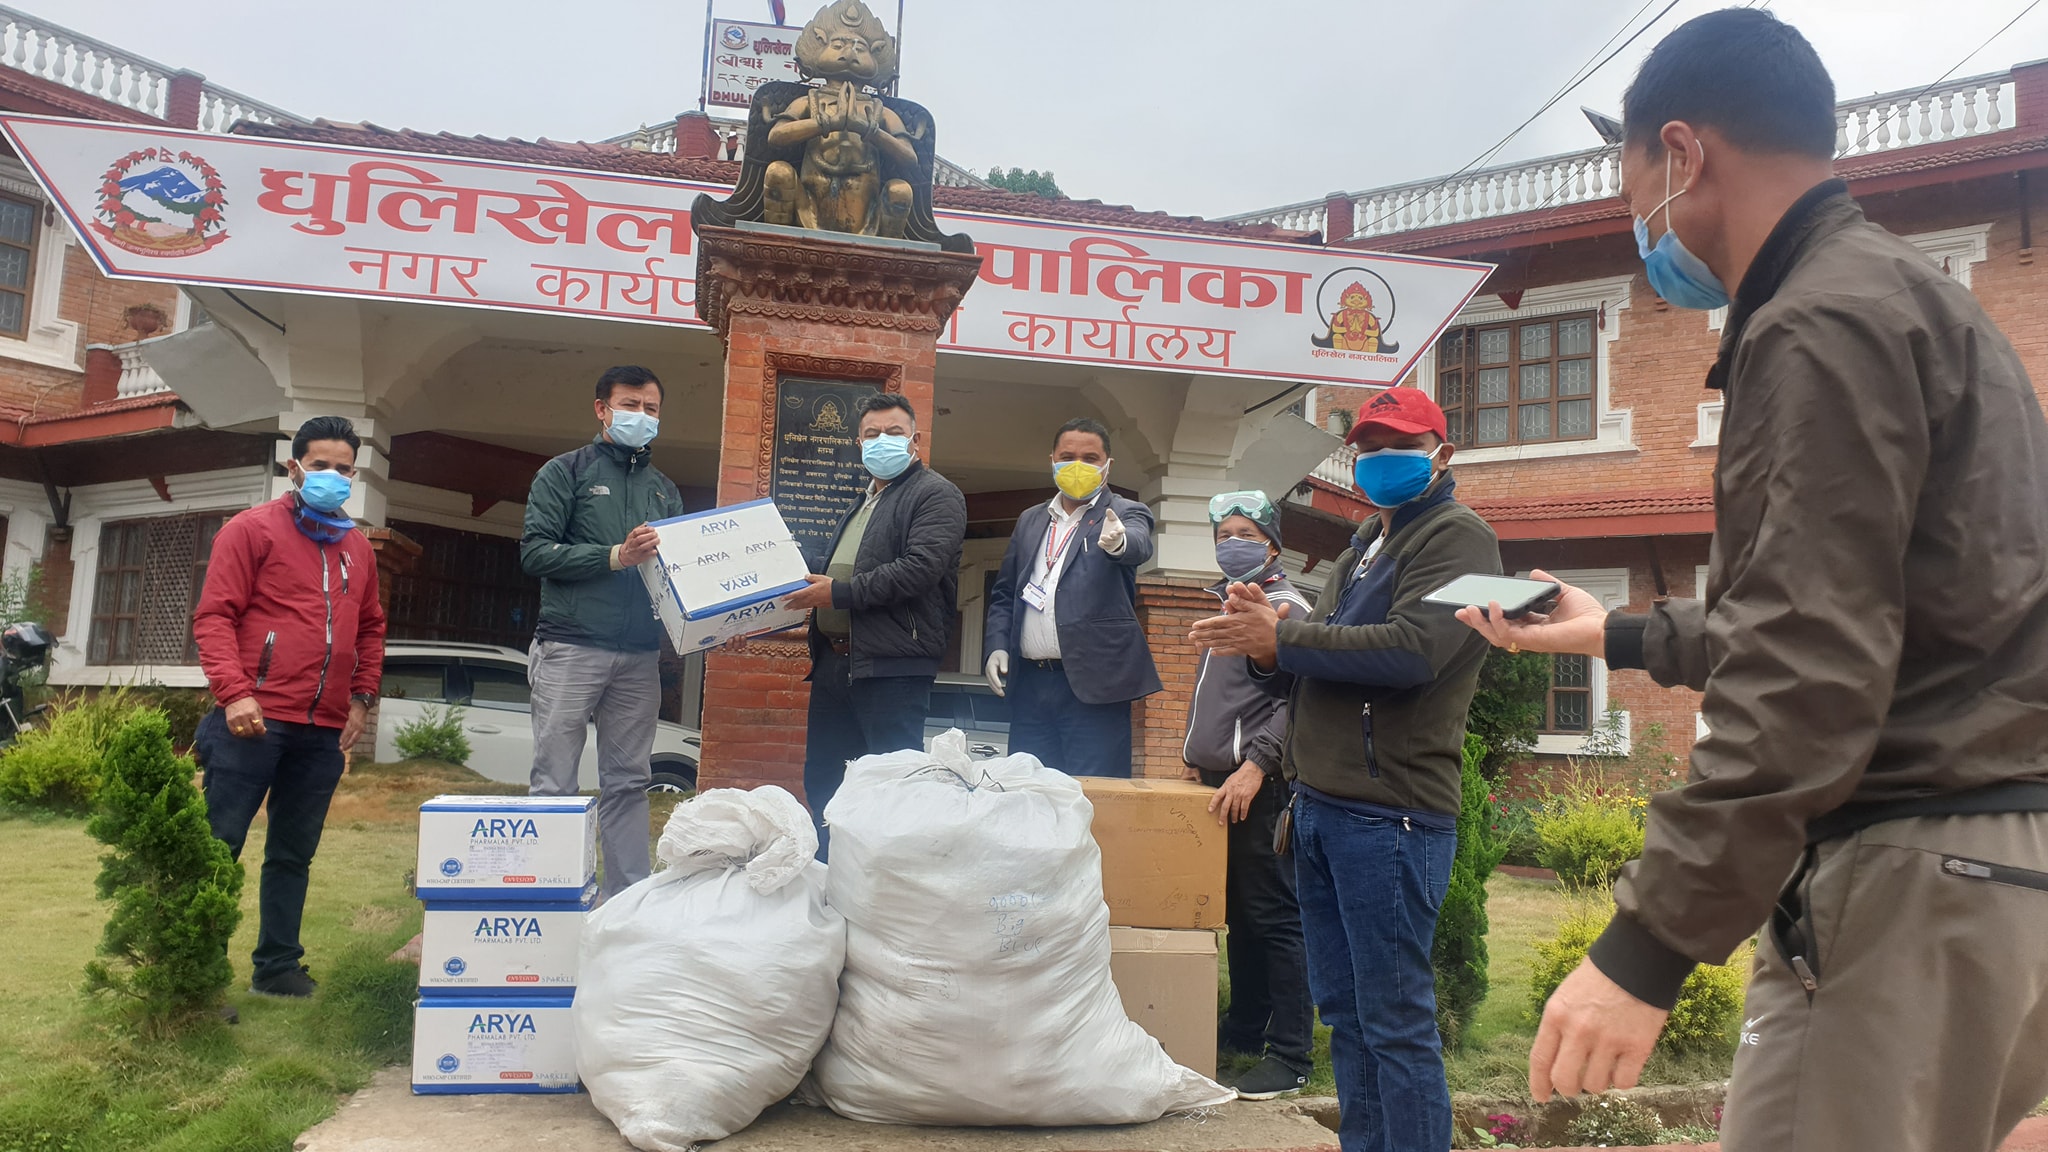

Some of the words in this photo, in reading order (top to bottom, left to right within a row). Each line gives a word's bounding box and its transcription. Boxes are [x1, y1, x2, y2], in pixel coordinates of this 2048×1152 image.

[713, 91, 752, 103] DHULI
[257, 161, 692, 256] धुलिखेल
[973, 236, 1312, 314] पालिका
[344, 246, 487, 298] नगर
[1002, 304, 1236, 367] कार्यालय
[1311, 348, 1346, 359] धुलिखेल
[1348, 353, 1398, 364] नगरपालिका
[701, 519, 740, 534] ARYA
[745, 540, 777, 554] ARYA
[697, 551, 730, 566] ARYA
[720, 573, 759, 592] ARYA
[725, 601, 776, 622] ARYA
[471, 819, 539, 838] ARYA
[475, 918, 542, 937] ARYA
[469, 1014, 536, 1033] ARYA
